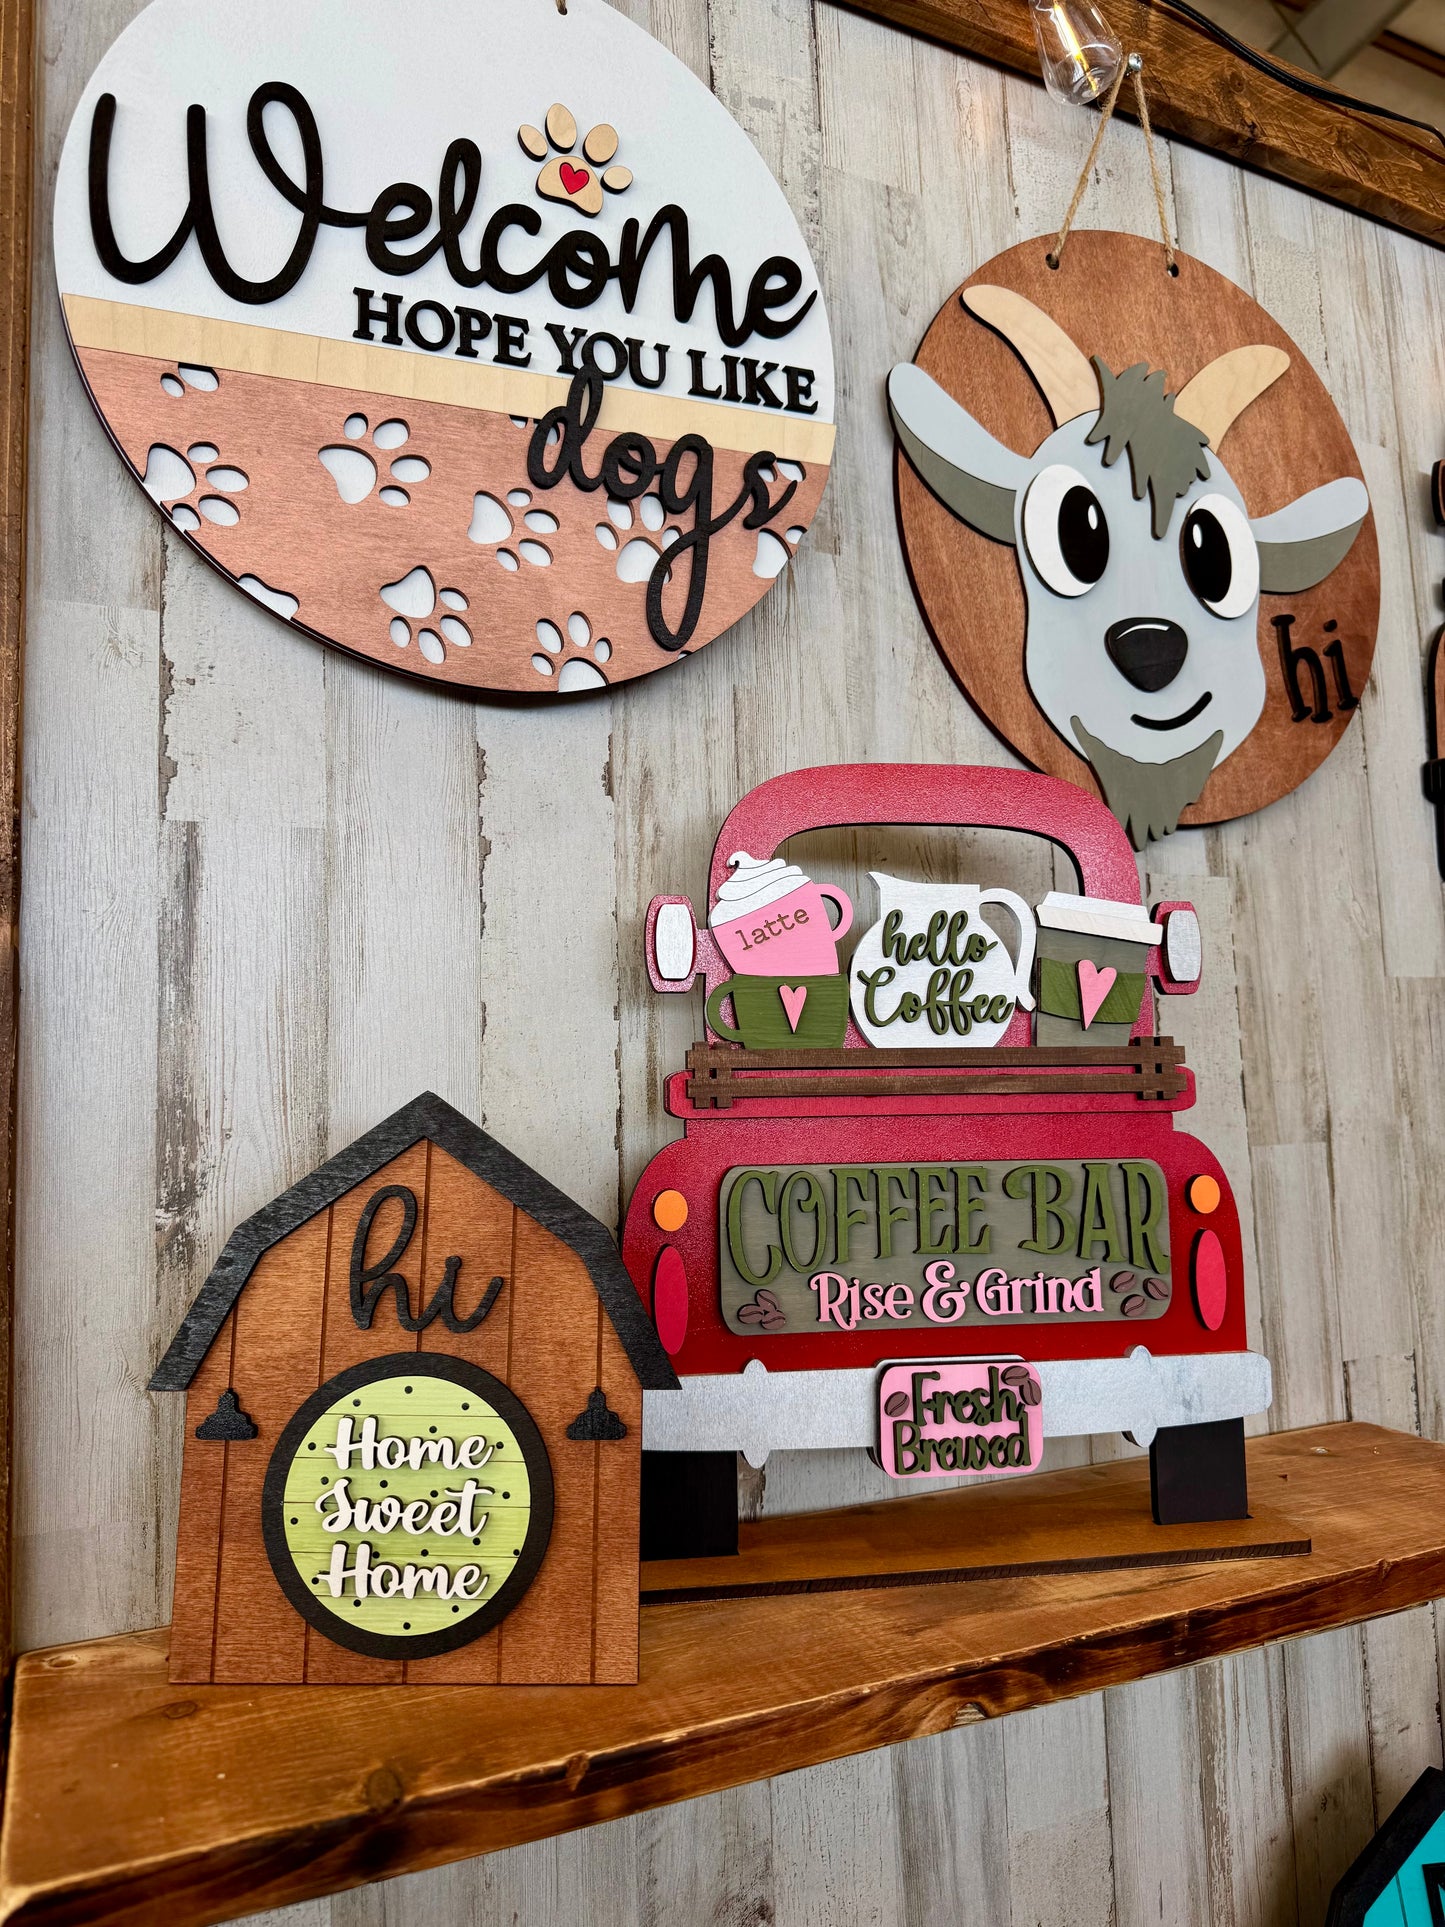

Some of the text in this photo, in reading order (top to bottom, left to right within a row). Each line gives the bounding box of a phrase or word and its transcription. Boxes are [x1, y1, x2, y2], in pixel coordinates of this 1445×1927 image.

[89, 81, 817, 347] Welcome
[353, 287, 819, 414] HOPE YOU LIKE
[526, 365, 798, 651] dogs
[1270, 613, 1360, 724] hi
[735, 907, 810, 952] latte
[882, 908, 998, 967] hello
[857, 967, 1015, 1036] Coffee
[727, 1161, 1170, 1286] COFFEE BAR
[349, 1184, 505, 1333] hi
[809, 1260, 1105, 1331] Rise & Grind
[911, 1366, 1025, 1427] Fresh
[323, 1414, 495, 1471] Home
[893, 1410, 1031, 1477] Brewed
[314, 1477, 495, 1538] Sweet
[317, 1540, 489, 1600] Home
